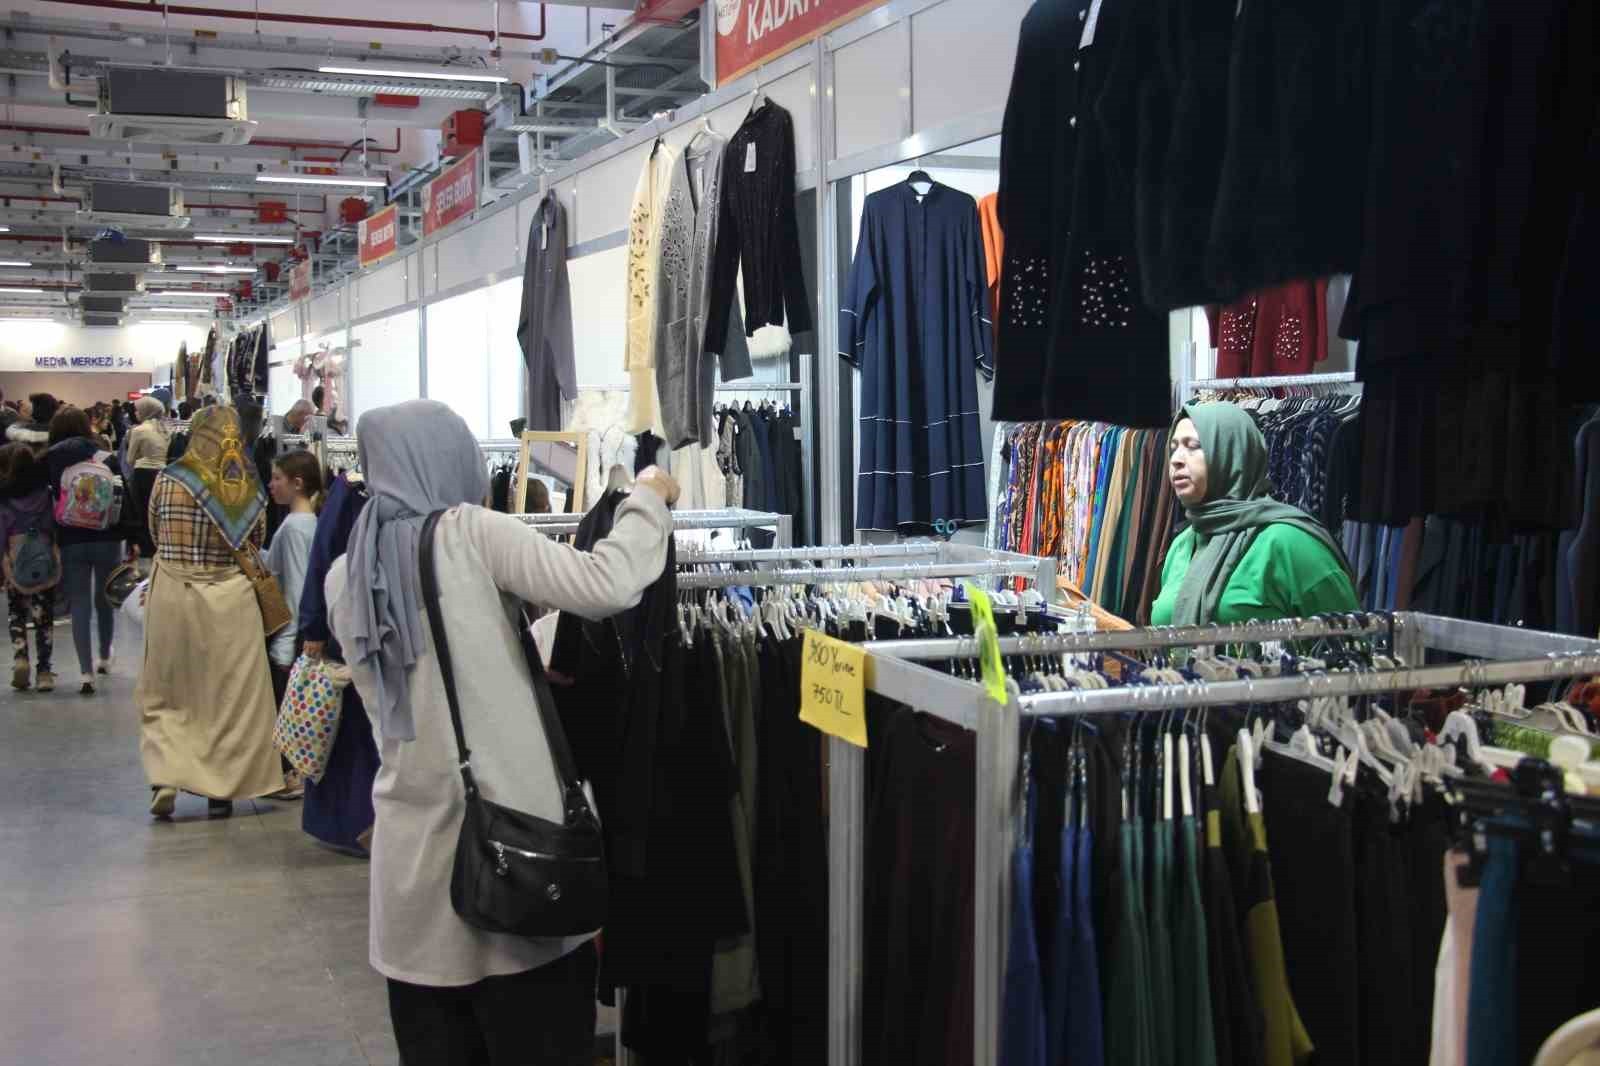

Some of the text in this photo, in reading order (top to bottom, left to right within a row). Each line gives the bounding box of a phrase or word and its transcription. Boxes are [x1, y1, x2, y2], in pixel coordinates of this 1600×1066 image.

[35, 356, 67, 367] MEDYA
[812, 683, 852, 716] 750 TL
